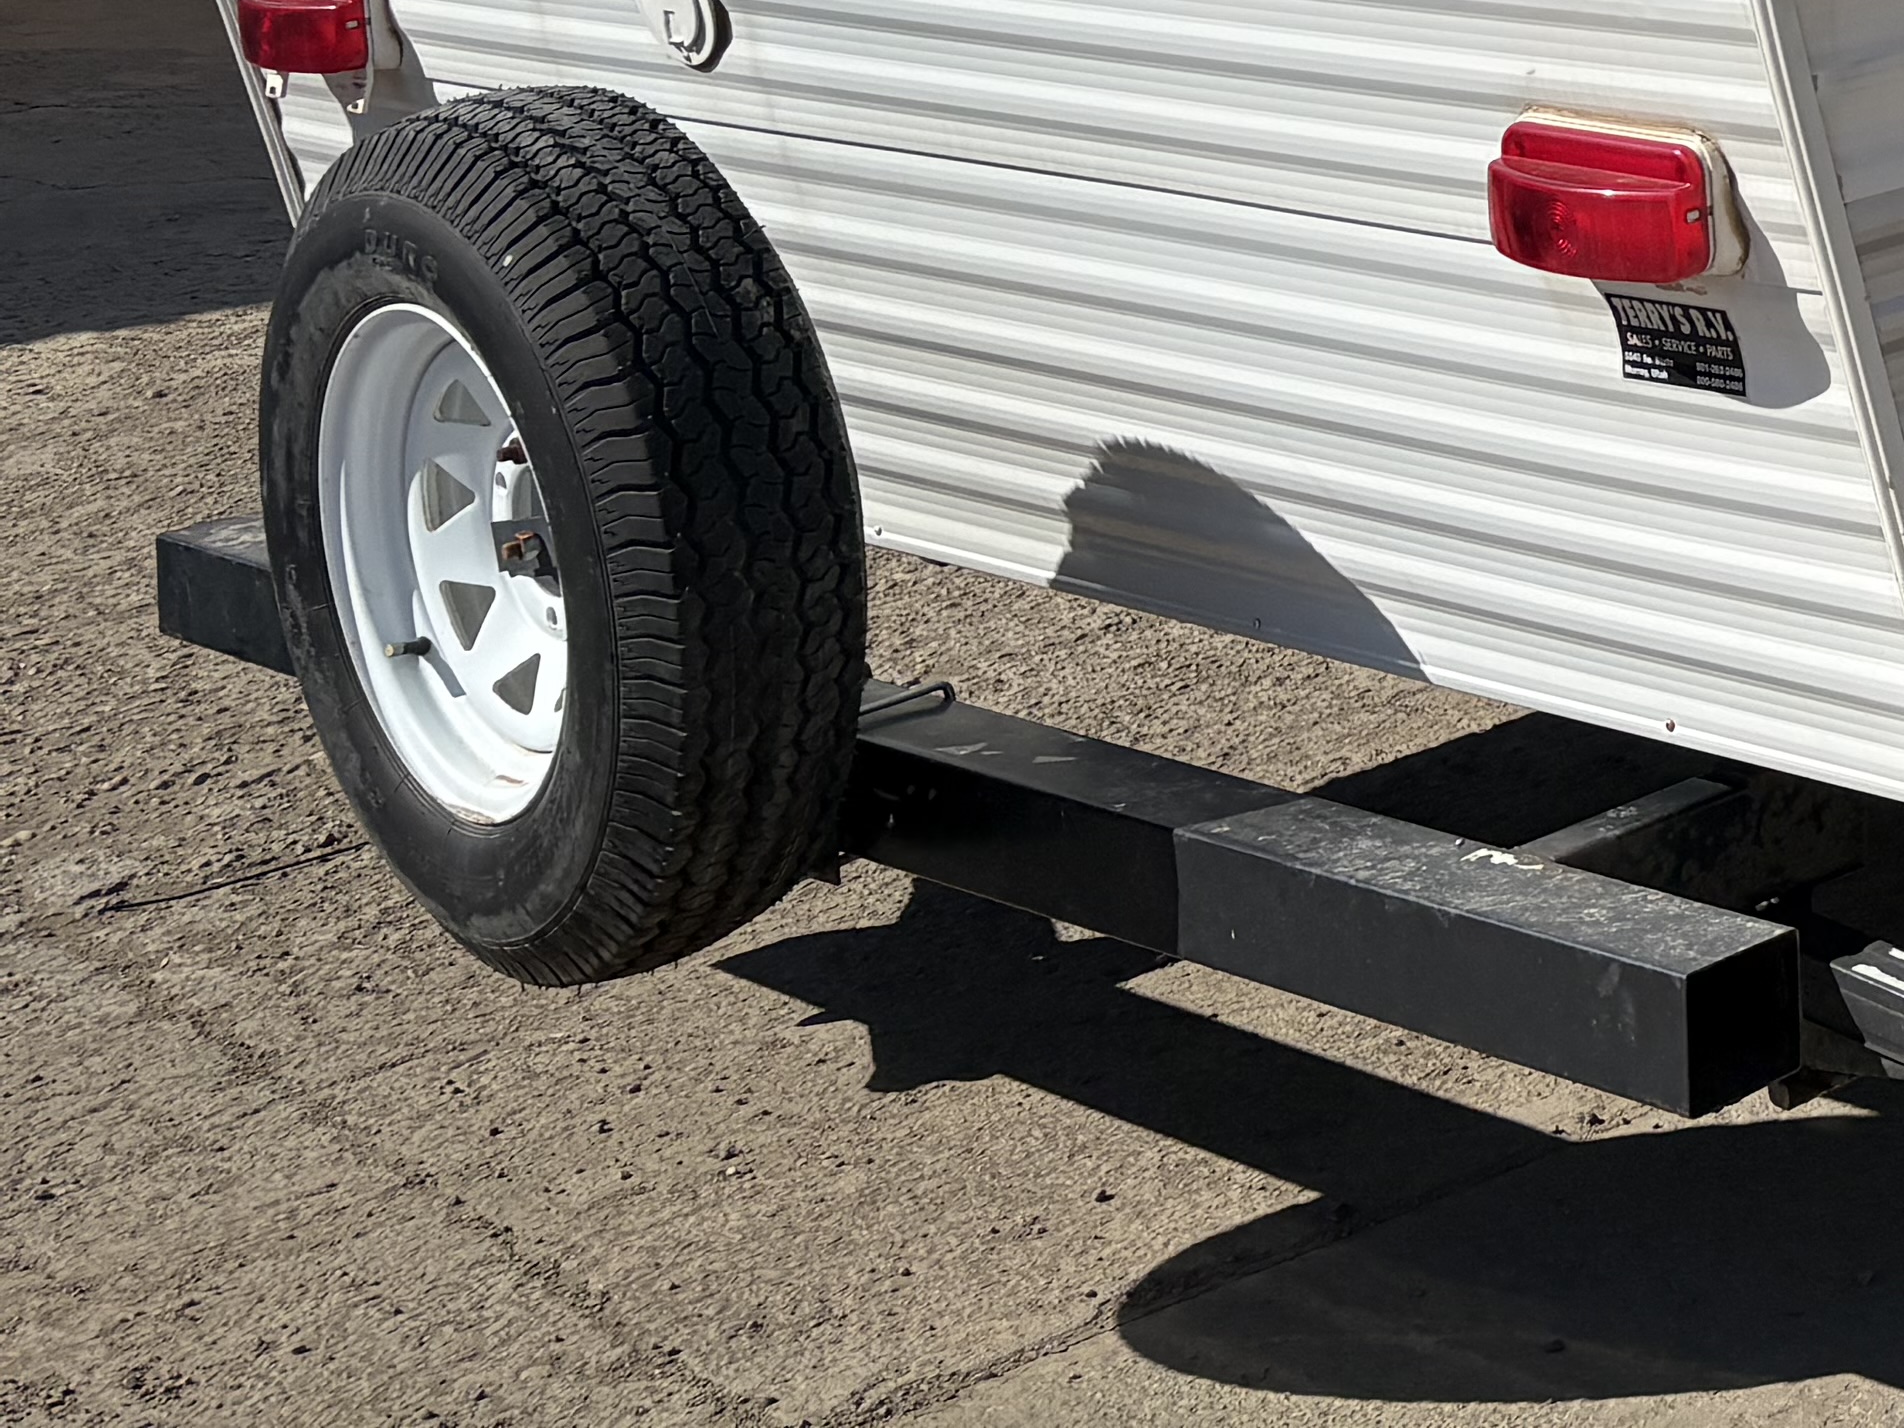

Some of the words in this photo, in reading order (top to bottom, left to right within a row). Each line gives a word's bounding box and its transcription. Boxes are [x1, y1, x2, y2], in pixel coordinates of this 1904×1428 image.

[1610, 296, 1692, 335] TERRY'S
[1688, 307, 1734, 341] R.V.
[1626, 332, 1653, 348] SALES
[1661, 337, 1697, 355] SERVICE
[1705, 344, 1734, 361] PARTS
